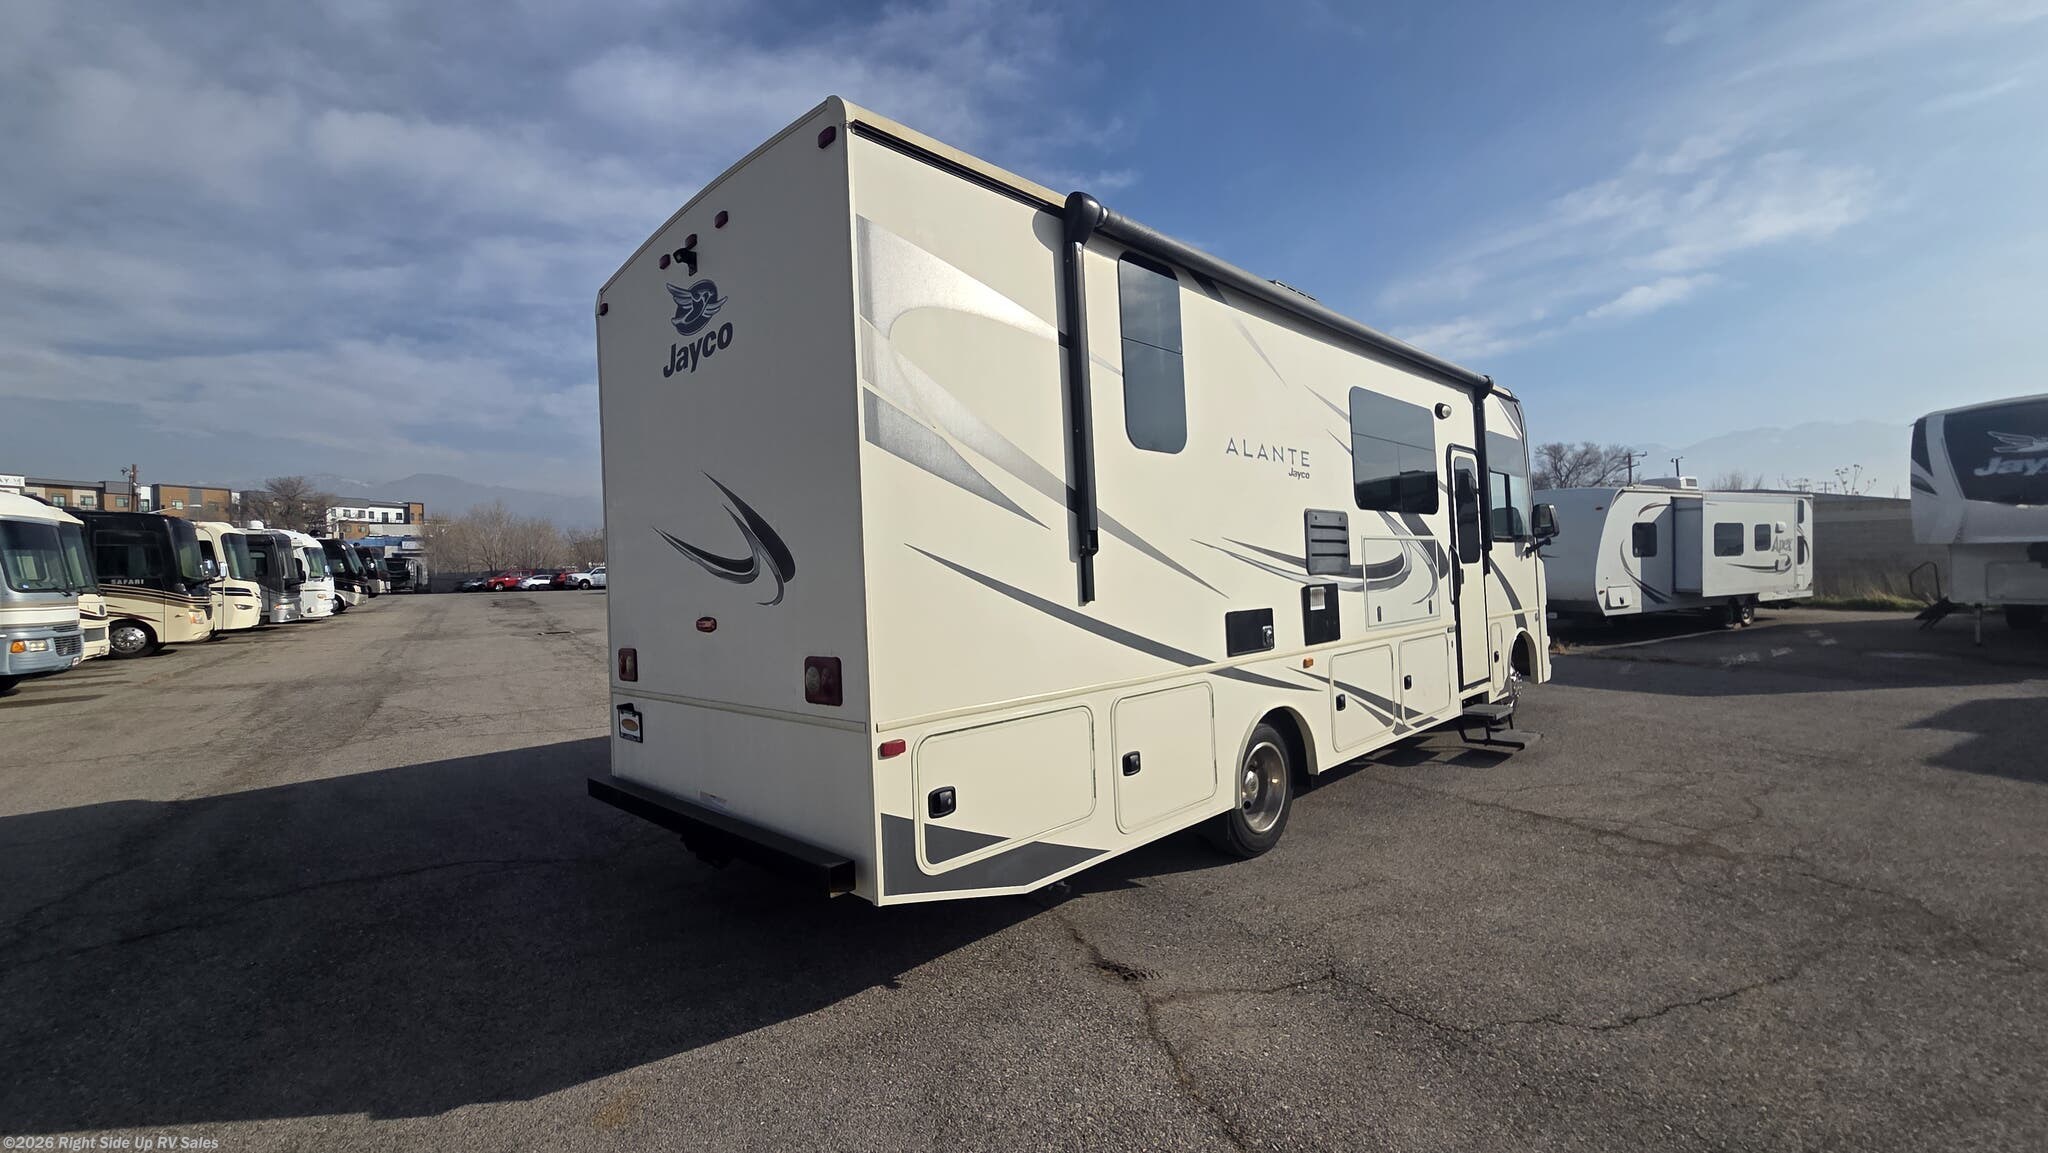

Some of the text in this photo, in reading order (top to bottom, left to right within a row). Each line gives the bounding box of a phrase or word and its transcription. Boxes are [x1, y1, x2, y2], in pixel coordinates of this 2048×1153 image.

[663, 322, 733, 378] Jayco
[1226, 437, 1310, 467] ALANTE
[1288, 467, 1310, 480] Jayco
